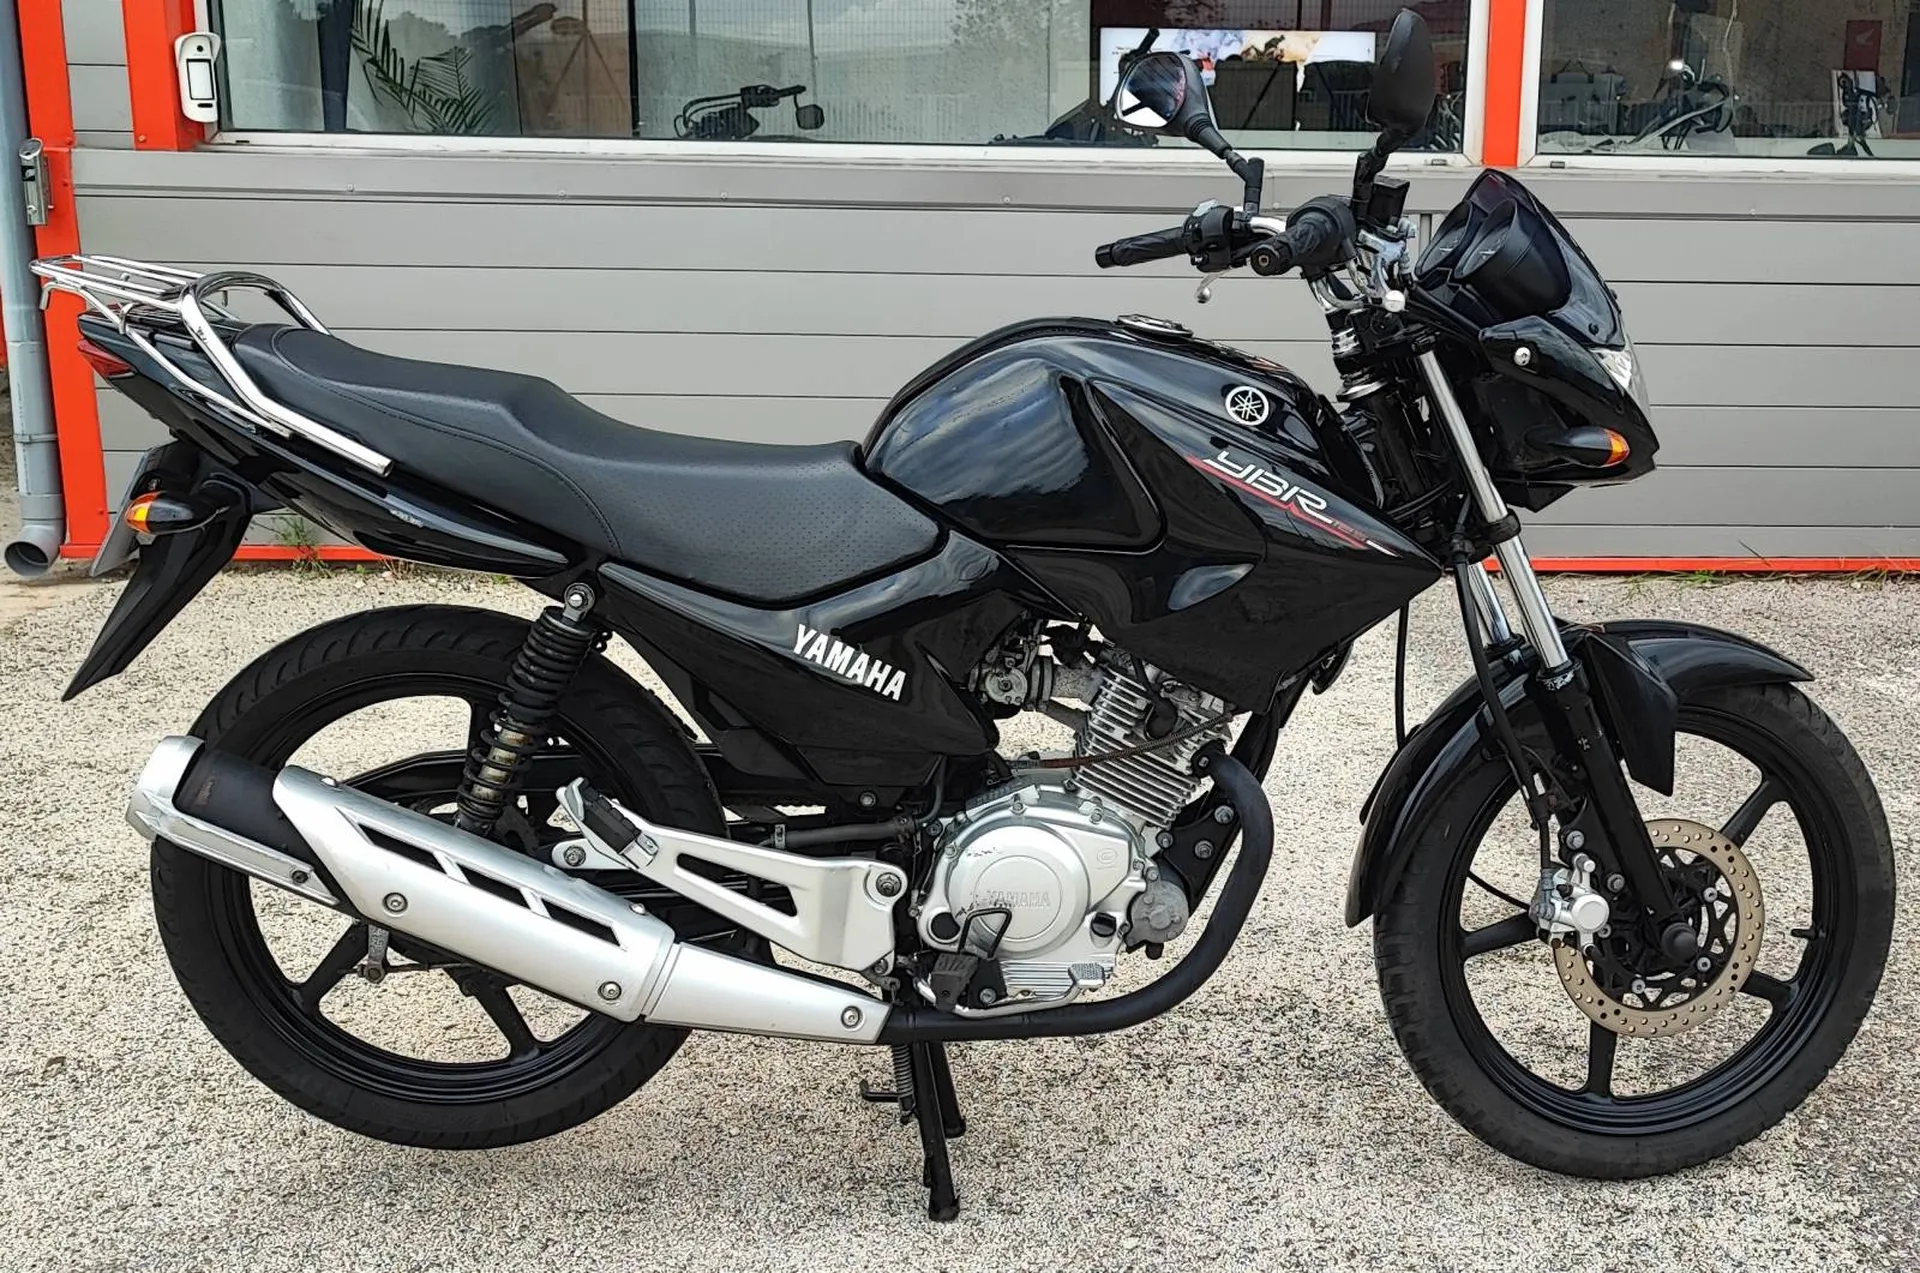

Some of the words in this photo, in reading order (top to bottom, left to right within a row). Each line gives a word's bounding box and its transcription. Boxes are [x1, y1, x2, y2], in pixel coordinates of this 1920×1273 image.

[1202, 451, 1333, 524] YBR
[793, 623, 907, 701] YAMAHA
[987, 890, 1051, 908] YAMAHA
